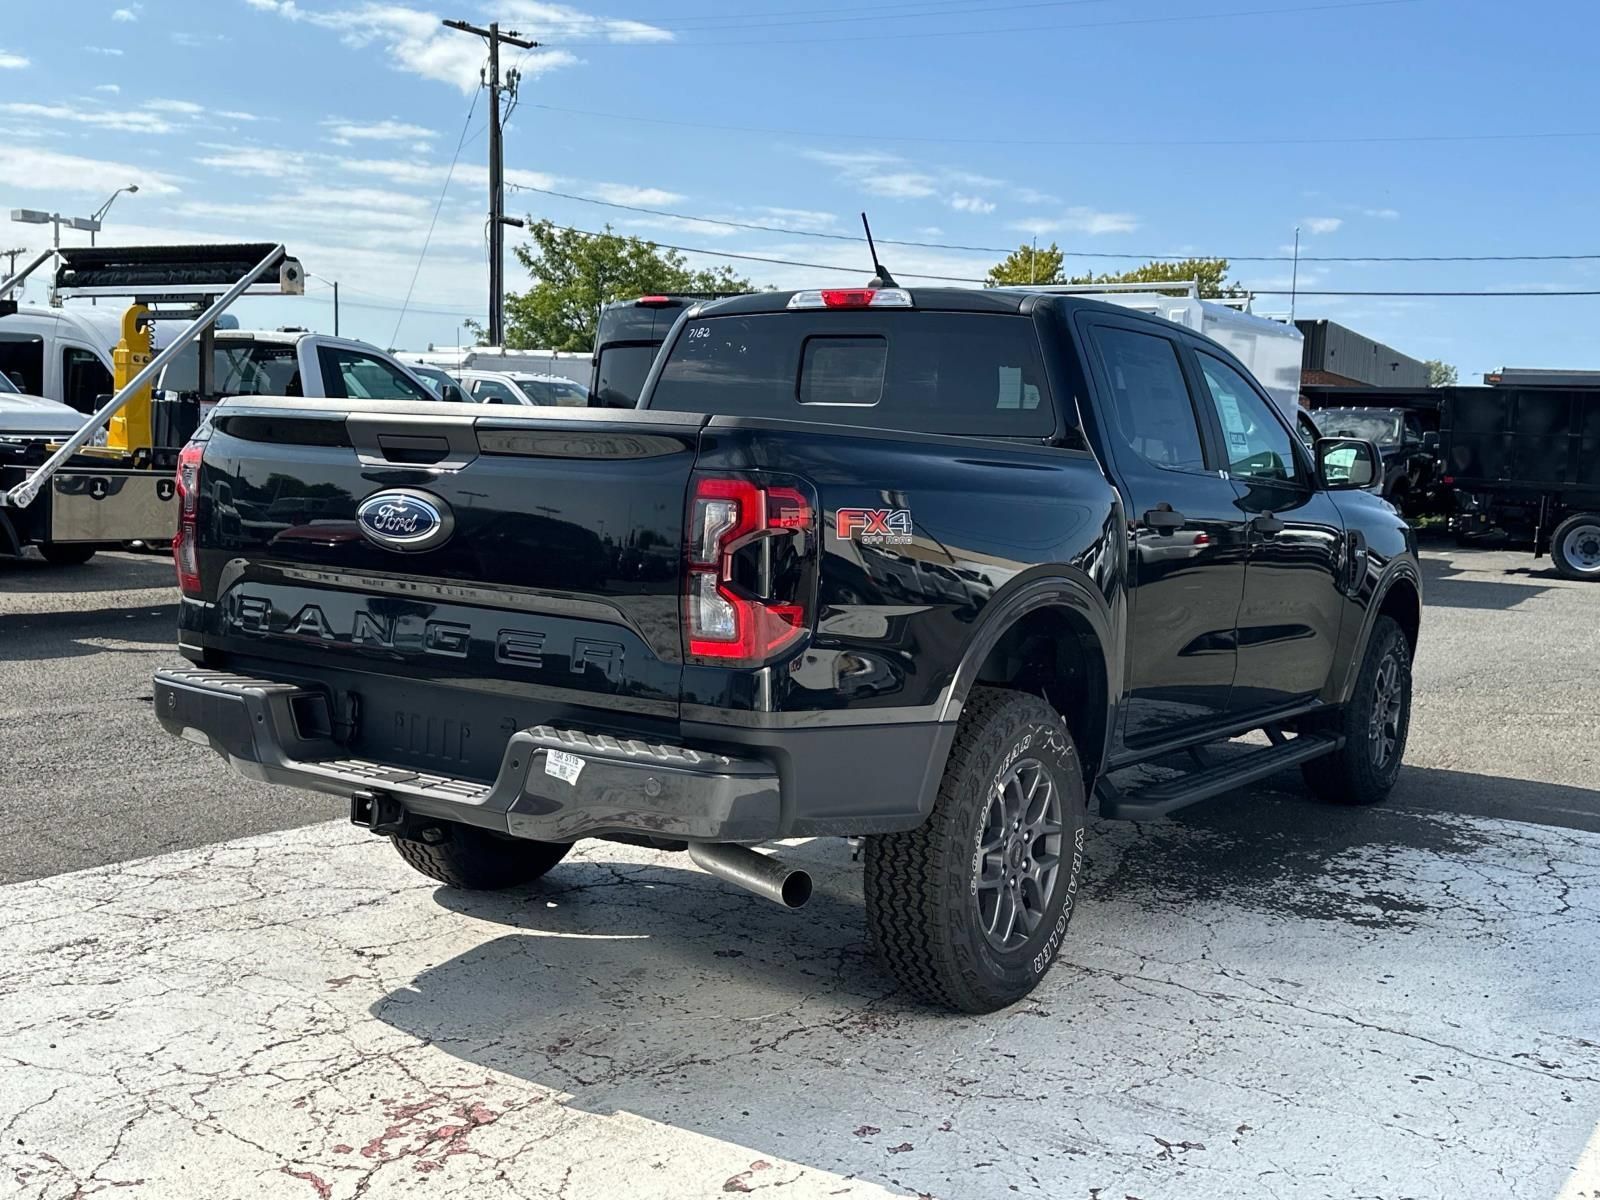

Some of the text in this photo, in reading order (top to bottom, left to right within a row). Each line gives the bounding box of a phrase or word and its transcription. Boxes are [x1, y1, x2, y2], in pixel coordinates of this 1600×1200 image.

[688, 321, 711, 338] 7182
[373, 504, 418, 532] Ford
[836, 507, 913, 540] FX4
[861, 535, 913, 544] OFF ROAD
[230, 594, 626, 682] RANGER
[1033, 827, 1085, 974] WRANGLER
